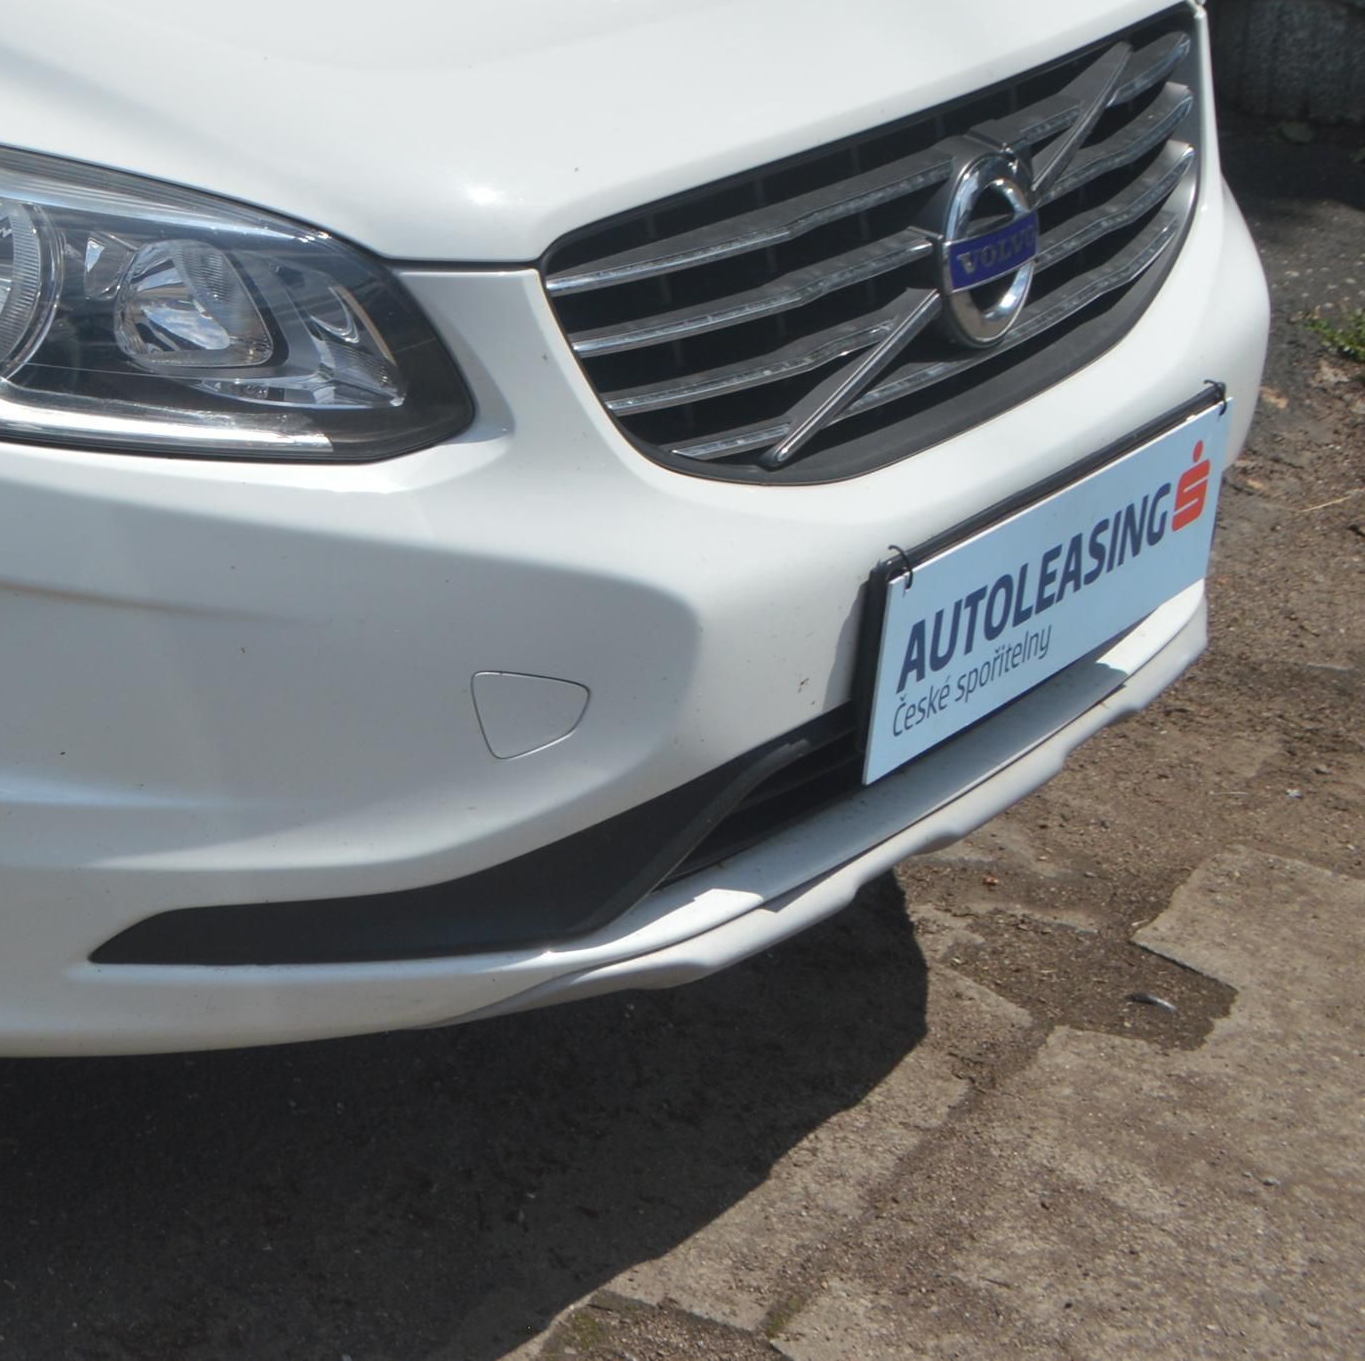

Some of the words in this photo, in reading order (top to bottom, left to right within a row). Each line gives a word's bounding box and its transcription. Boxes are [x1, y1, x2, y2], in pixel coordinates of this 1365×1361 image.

[956, 224, 1035, 275] VOLVO
[896, 483, 1172, 694] AUTOLEASING
[893, 674, 952, 738] České
[954, 624, 1052, 703] spořitelny
